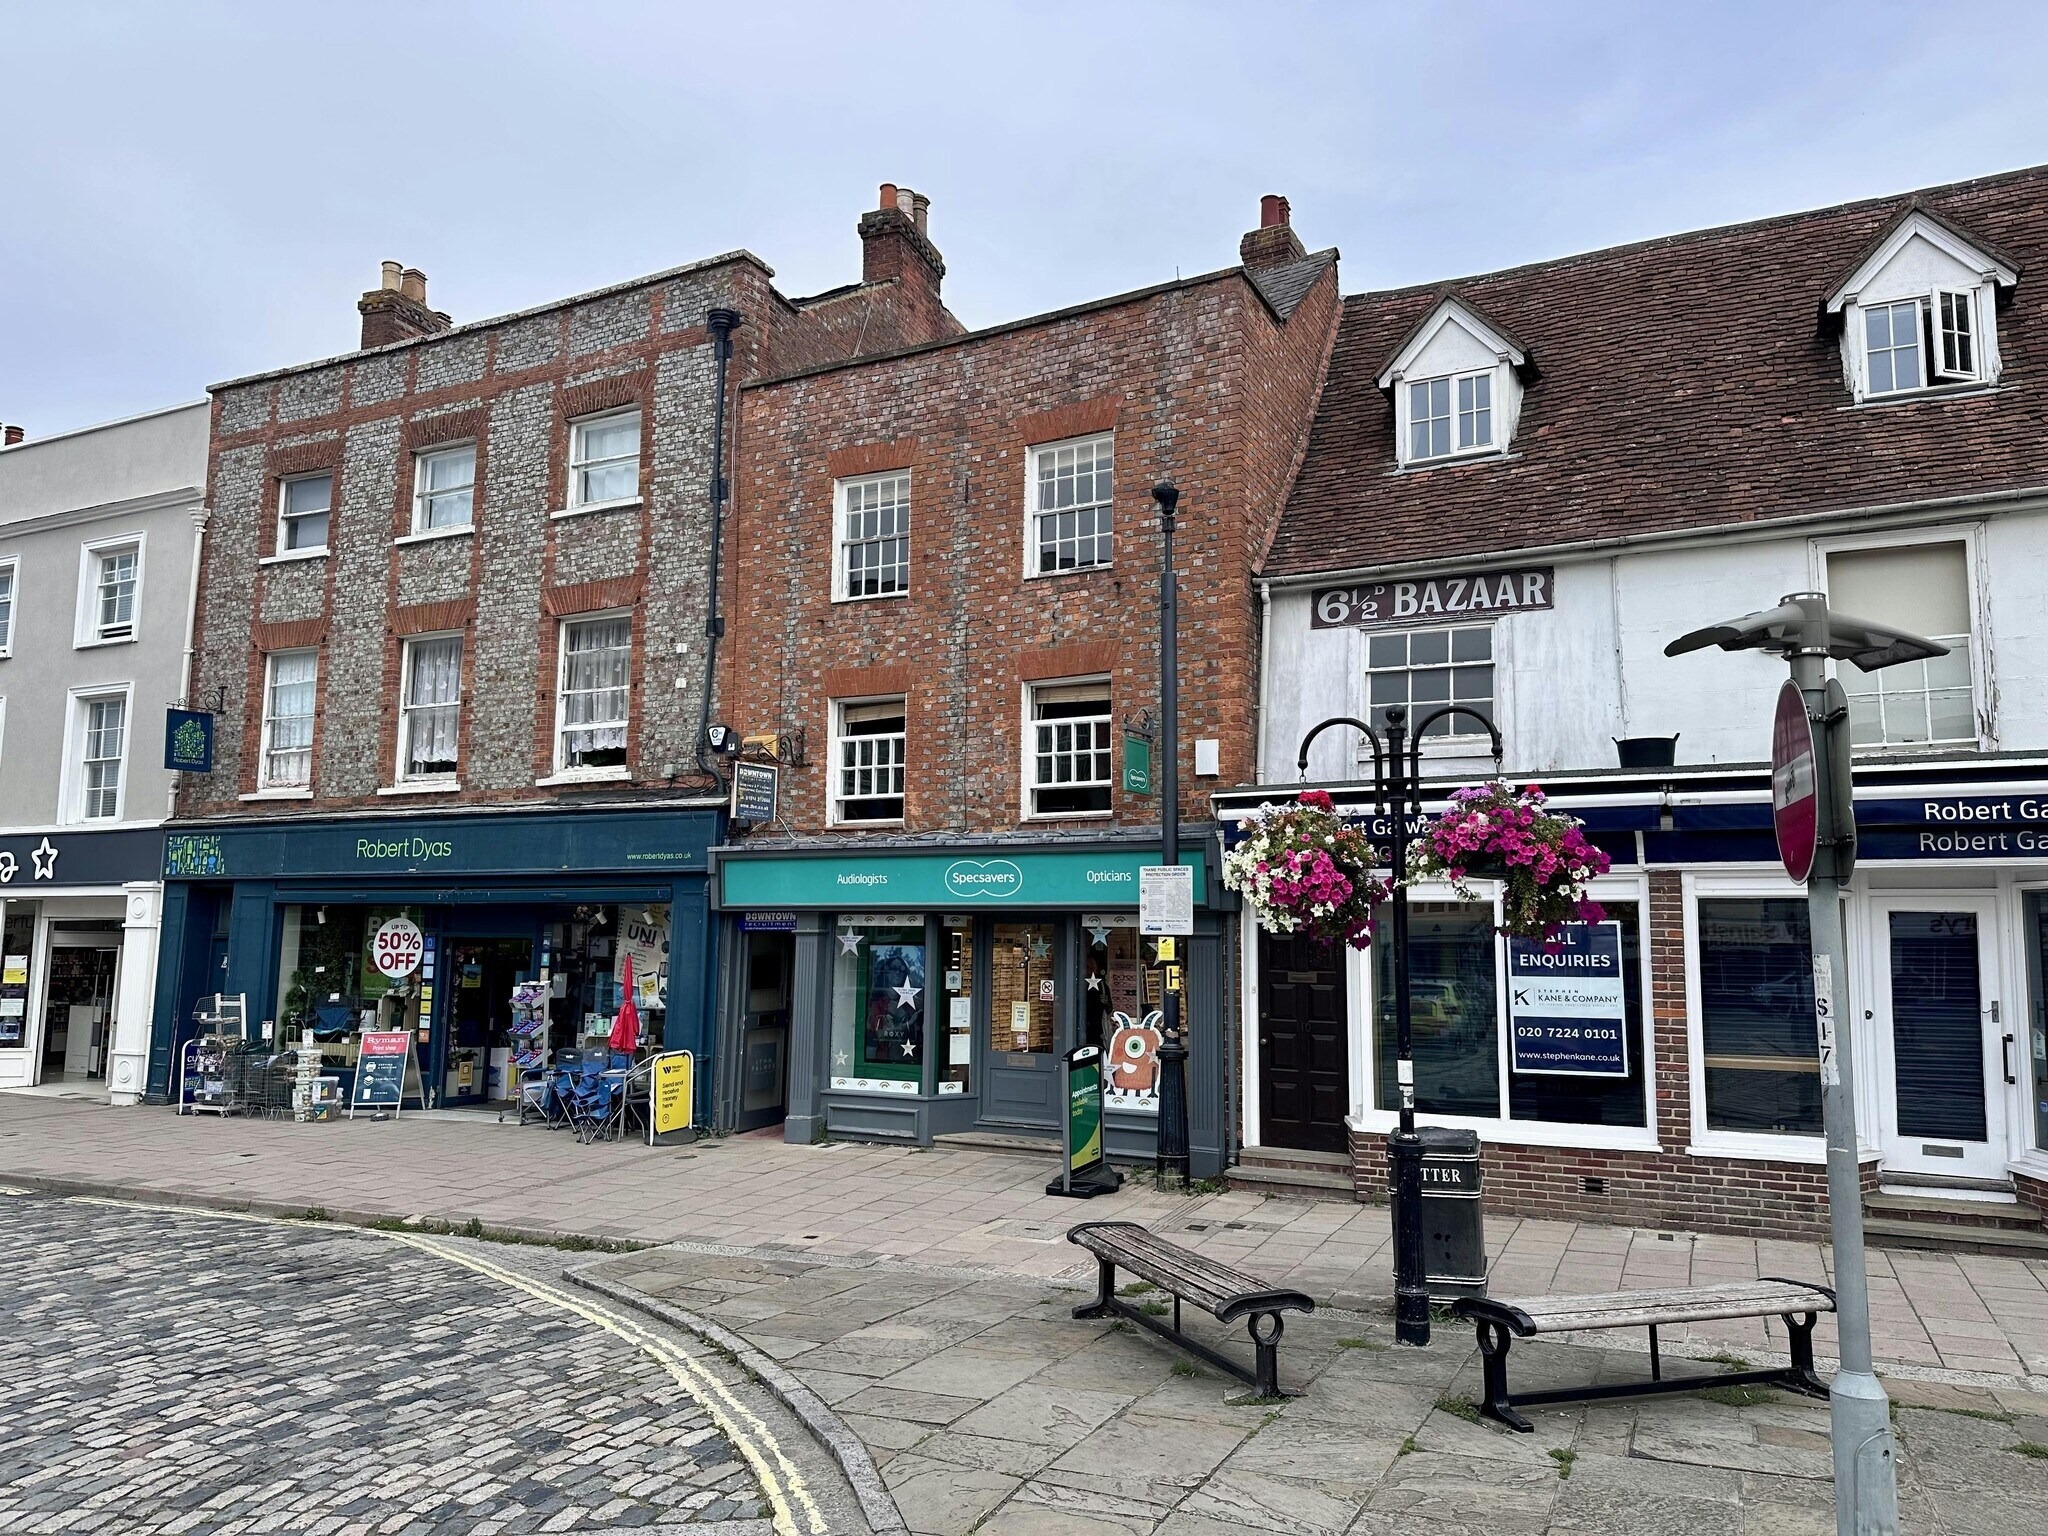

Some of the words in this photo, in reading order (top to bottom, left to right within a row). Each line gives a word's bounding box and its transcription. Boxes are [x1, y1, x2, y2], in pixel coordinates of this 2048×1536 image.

[1392, 572, 1547, 617] BAZAAR
[739, 768, 773, 779] DOWNTOWN
[1924, 801, 2012, 820] Robert
[1919, 831, 2008, 851] Robert
[356, 838, 409, 858] Robert
[412, 837, 452, 861] Dyas
[626, 852, 692, 860] www.robertdyas.co.uk
[836, 872, 888, 887] Audiologists
[952, 871, 1015, 886] Specsavers
[1086, 869, 1132, 884] Opticians
[745, 912, 797, 921] DOWNTOWN
[378, 932, 420, 950] 50%
[628, 924, 657, 943] UNI
[379, 952, 416, 970] OFF
[1519, 954, 1611, 968] ENQUIRIES
[1538, 994, 1562, 1002] KANE
[1572, 995, 1618, 1003] COMPANY
[366, 1036, 405, 1044] Ryman
[1518, 1027, 1542, 1037] 020
[1547, 1027, 1580, 1038] 7224
[1584, 1029, 1617, 1039] 0101
[1518, 1051, 1620, 1062] www.stephenkane.co.uk
[1072, 1083, 1098, 1098] Appointments
[1072, 1107, 1083, 1117] today
[1420, 1167, 1461, 1182] TTER
